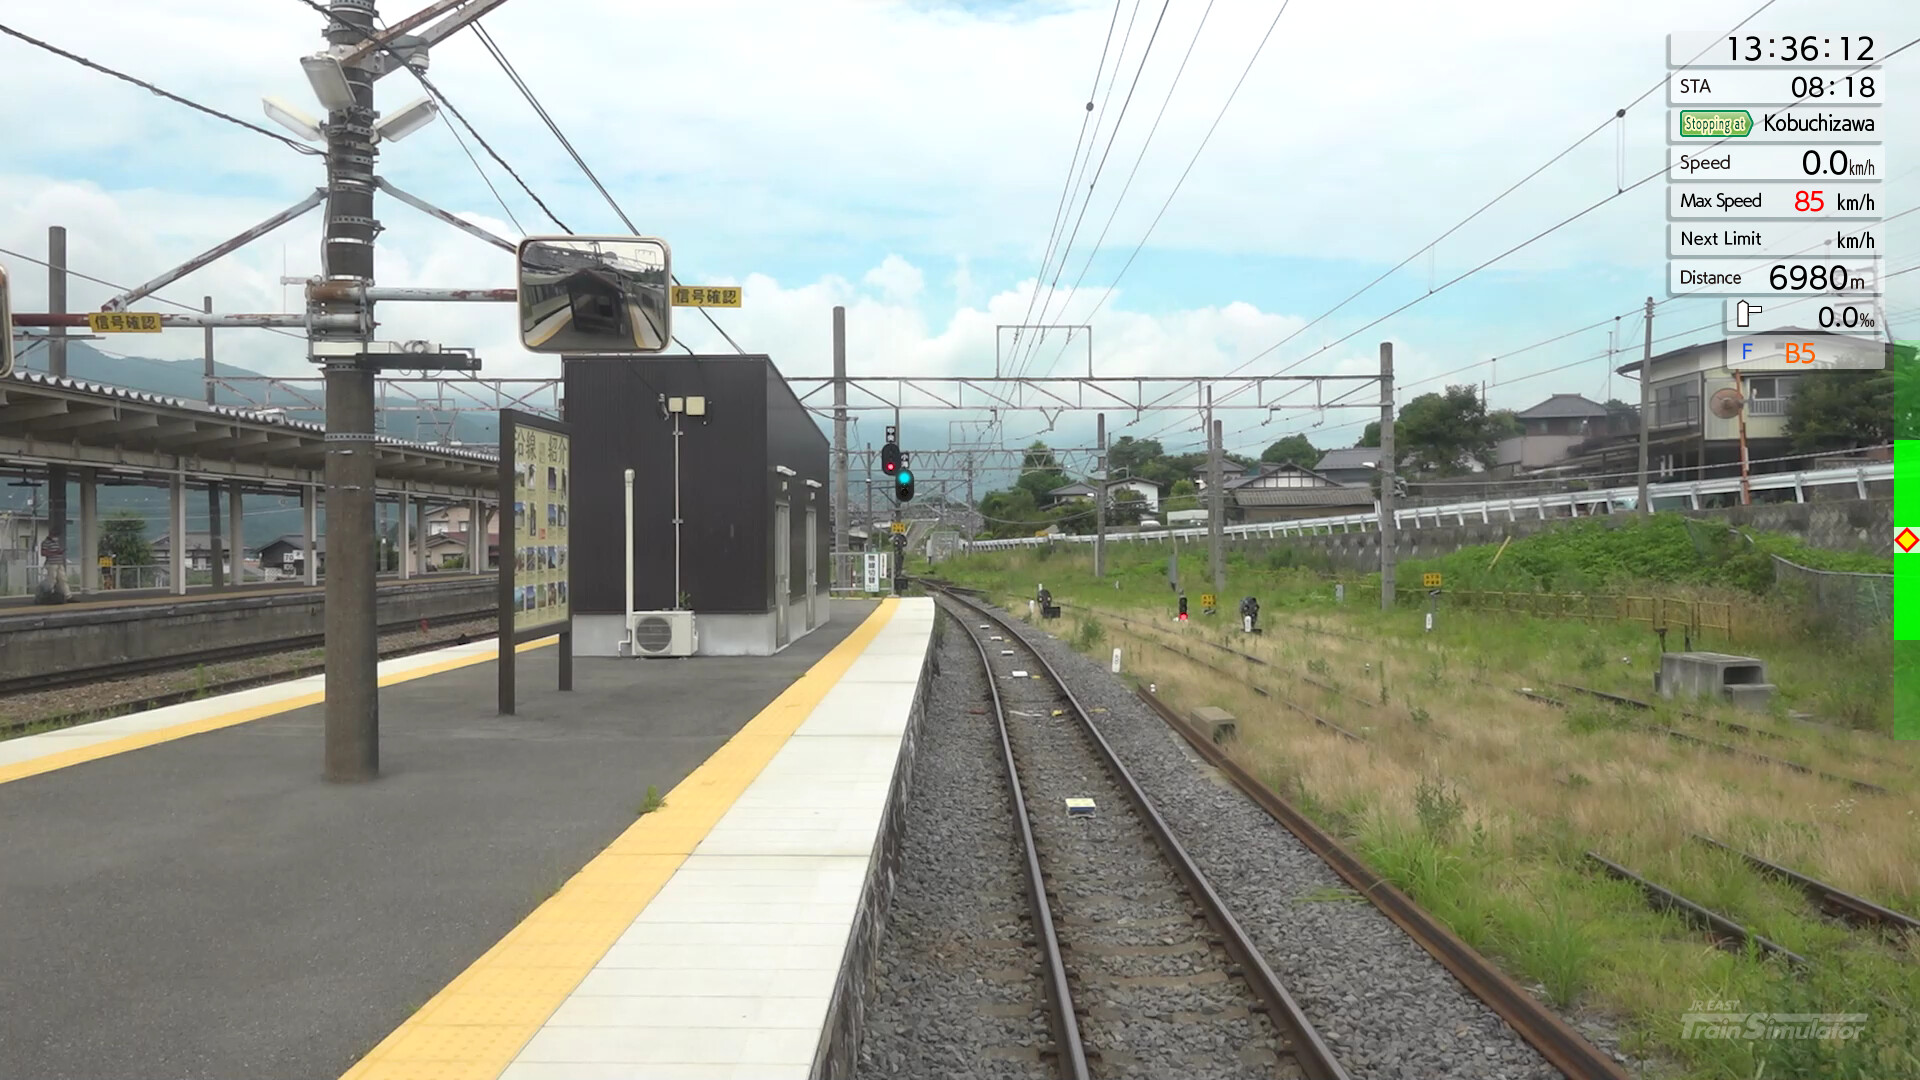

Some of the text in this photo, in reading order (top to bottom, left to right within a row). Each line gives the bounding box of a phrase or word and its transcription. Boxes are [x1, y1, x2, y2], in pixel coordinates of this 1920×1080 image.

[676, 288, 737, 305] 信号確認
[95, 315, 157, 330] 信号確認
